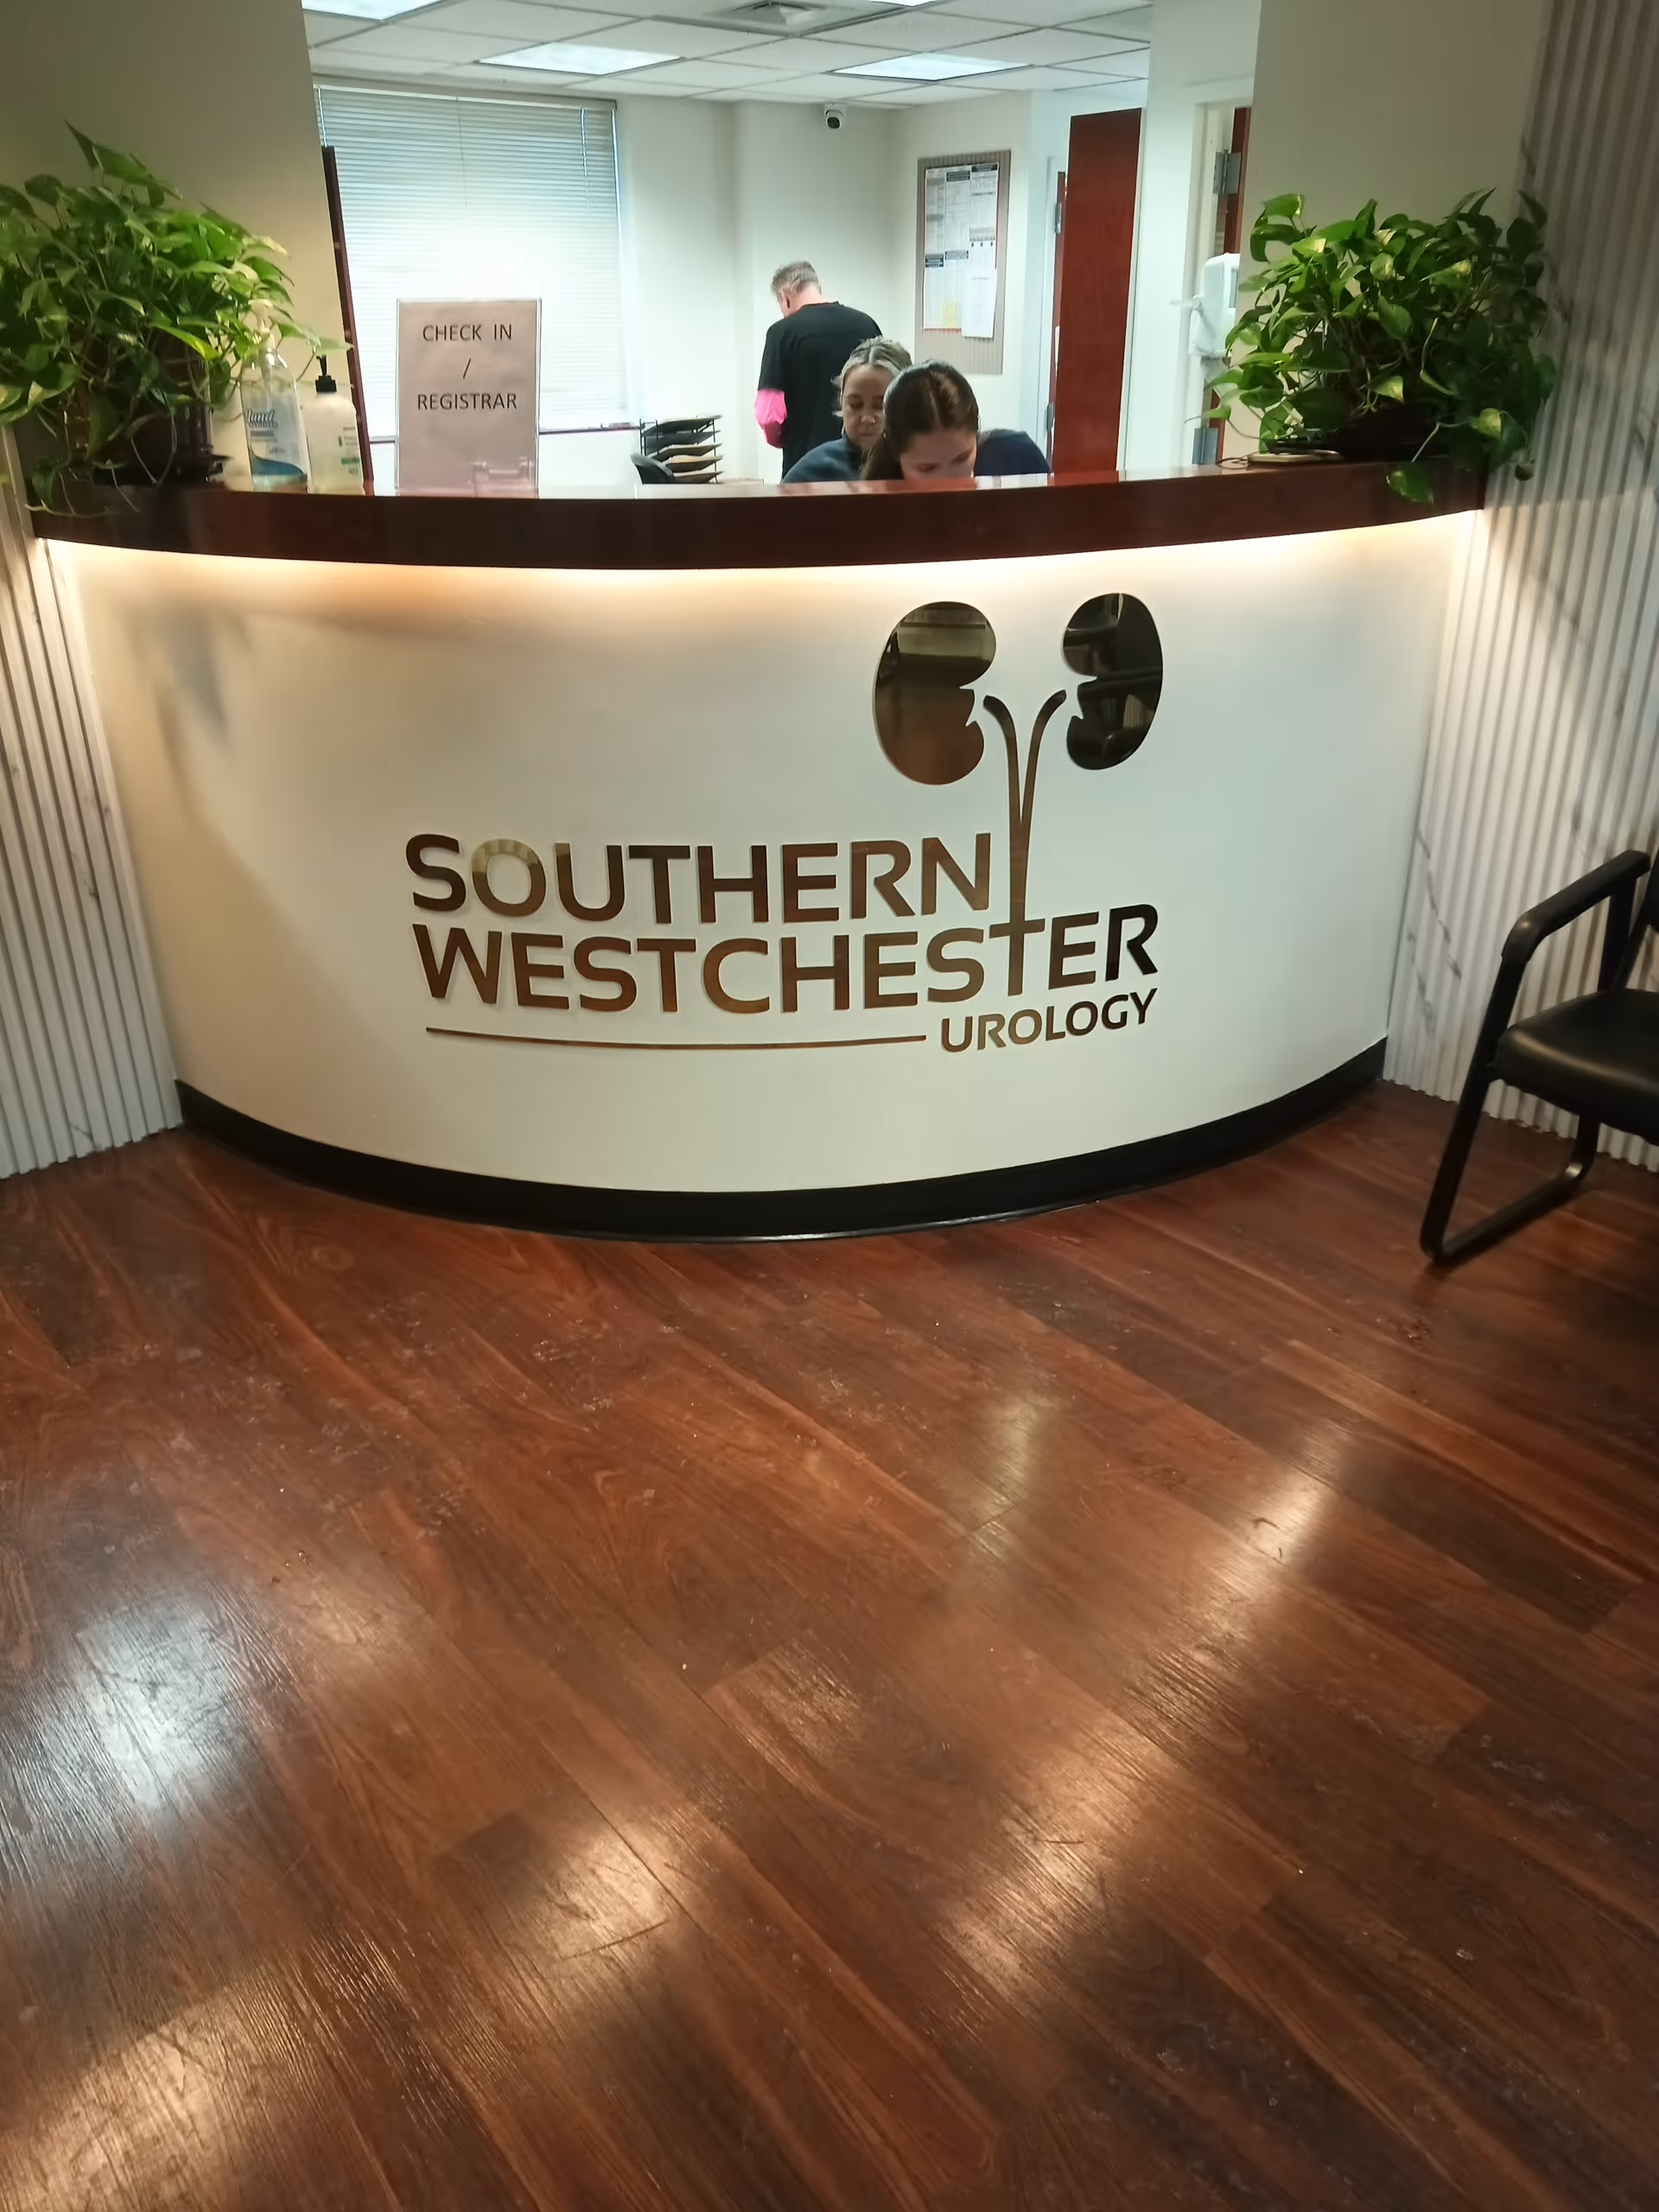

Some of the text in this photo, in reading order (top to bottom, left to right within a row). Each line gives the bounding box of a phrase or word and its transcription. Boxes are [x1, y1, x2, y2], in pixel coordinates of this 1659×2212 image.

[423, 324, 512, 341] CHECK IN
[462, 358, 472, 379] /
[417, 393, 518, 410] REGISTRAR
[405, 832, 991, 924] SOUTHERN
[412, 904, 1159, 1014] WESTCHESTER
[941, 988, 1158, 1052] UROLOGY
